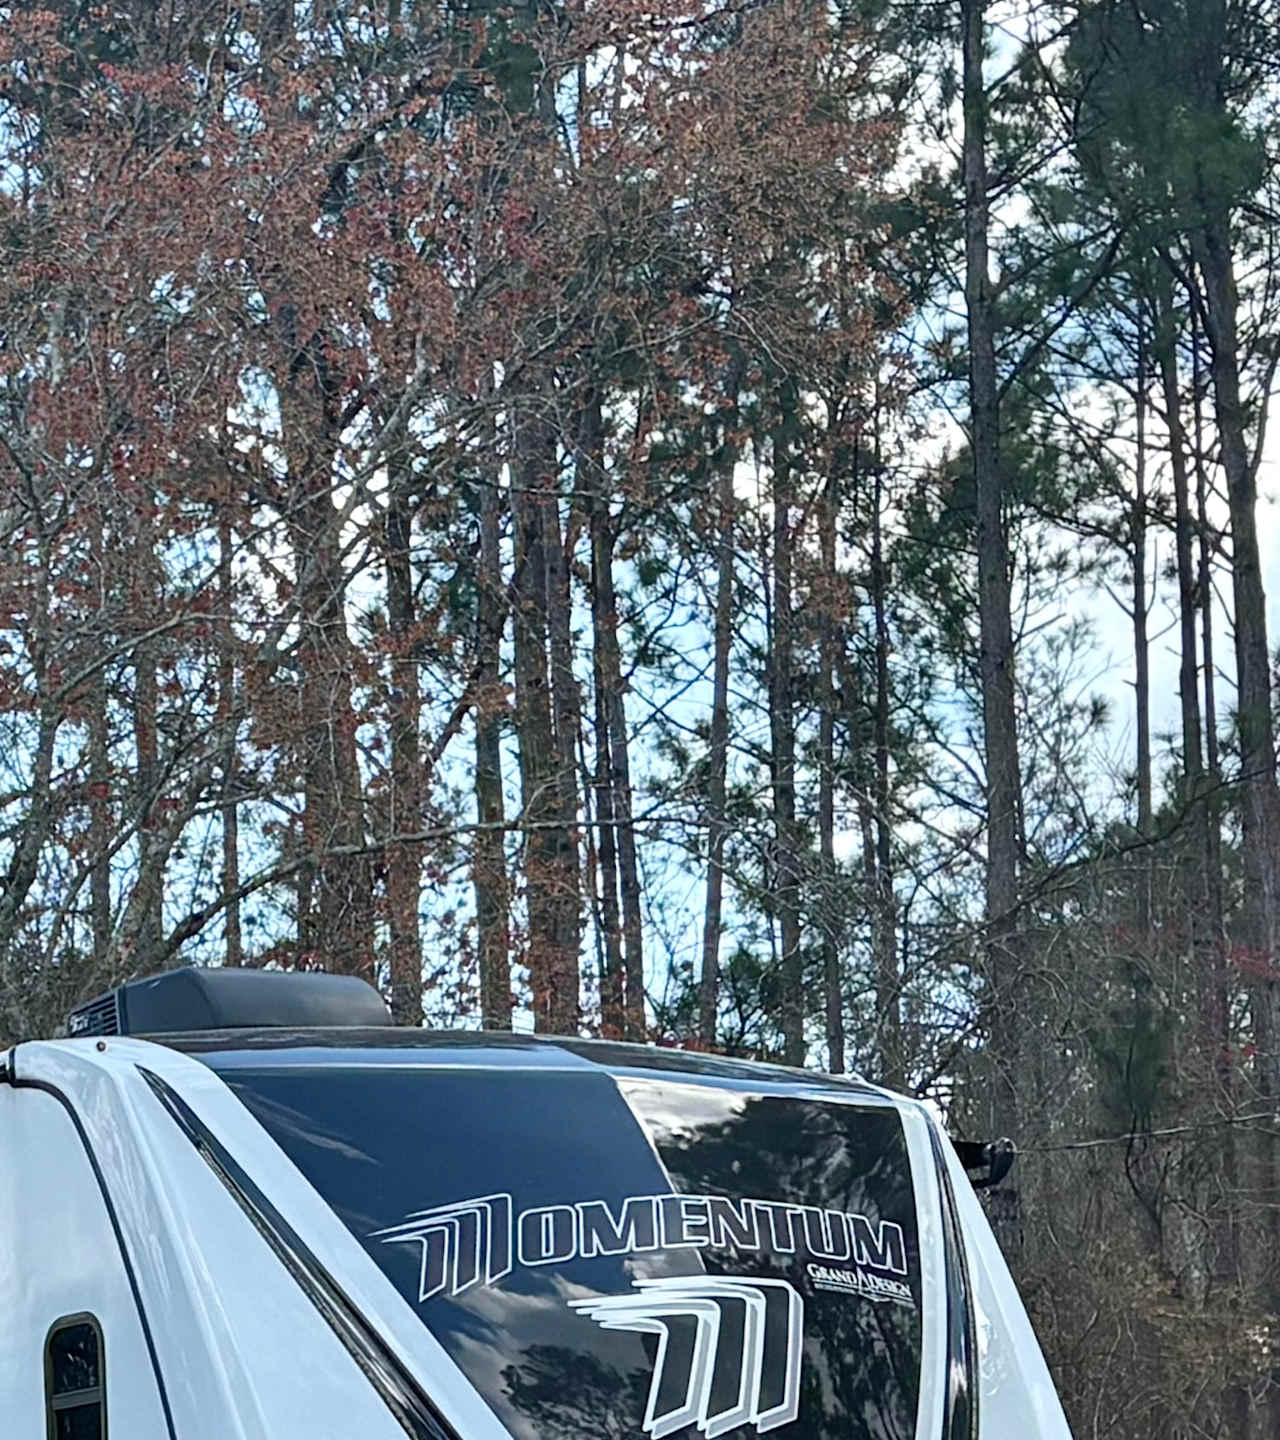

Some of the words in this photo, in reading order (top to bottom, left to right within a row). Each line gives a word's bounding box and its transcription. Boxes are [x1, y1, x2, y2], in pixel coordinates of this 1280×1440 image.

[367, 1192, 908, 1303] MOMENTUM
[806, 1263, 857, 1285] GRAND
[865, 1272, 913, 1298] DESIGN
